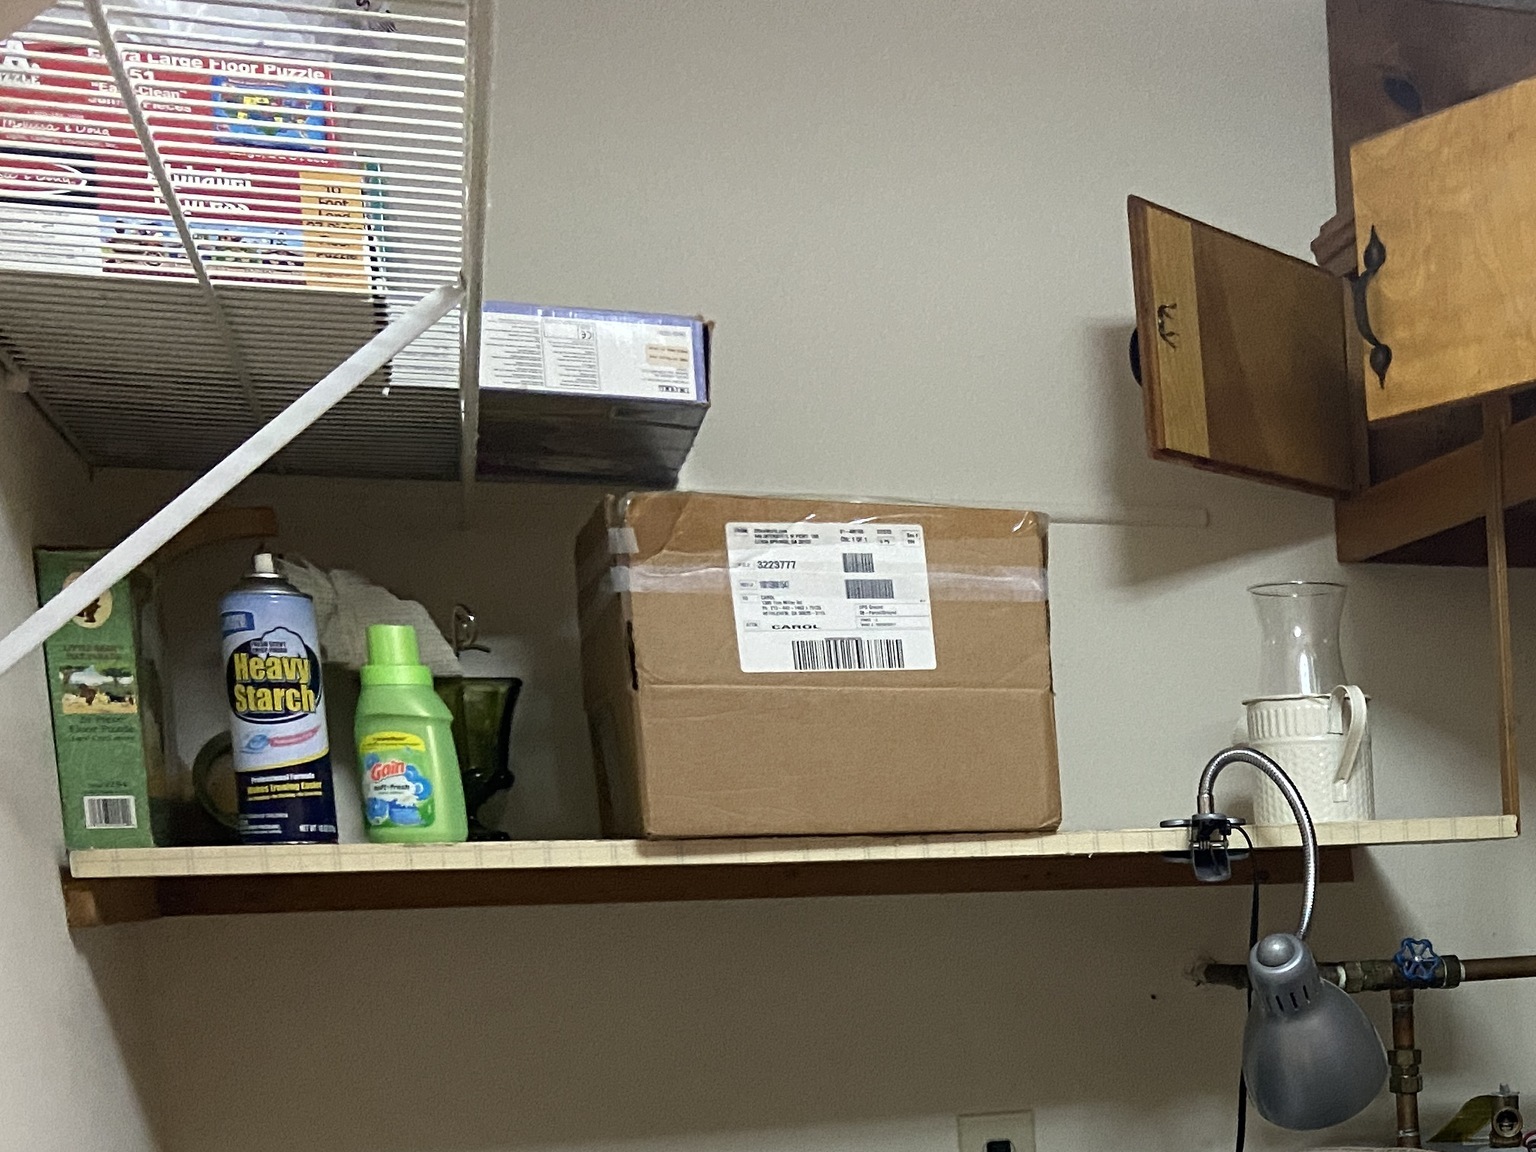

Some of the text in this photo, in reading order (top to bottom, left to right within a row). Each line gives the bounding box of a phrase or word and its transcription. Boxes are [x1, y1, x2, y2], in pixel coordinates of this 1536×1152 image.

[147, 52, 204, 70] Large
[263, 64, 326, 80] Puzzle
[756, 560, 797, 570] 3223777
[234, 652, 311, 684] Heavy
[234, 683, 317, 714] Starch
[371, 760, 406, 781] Gain
